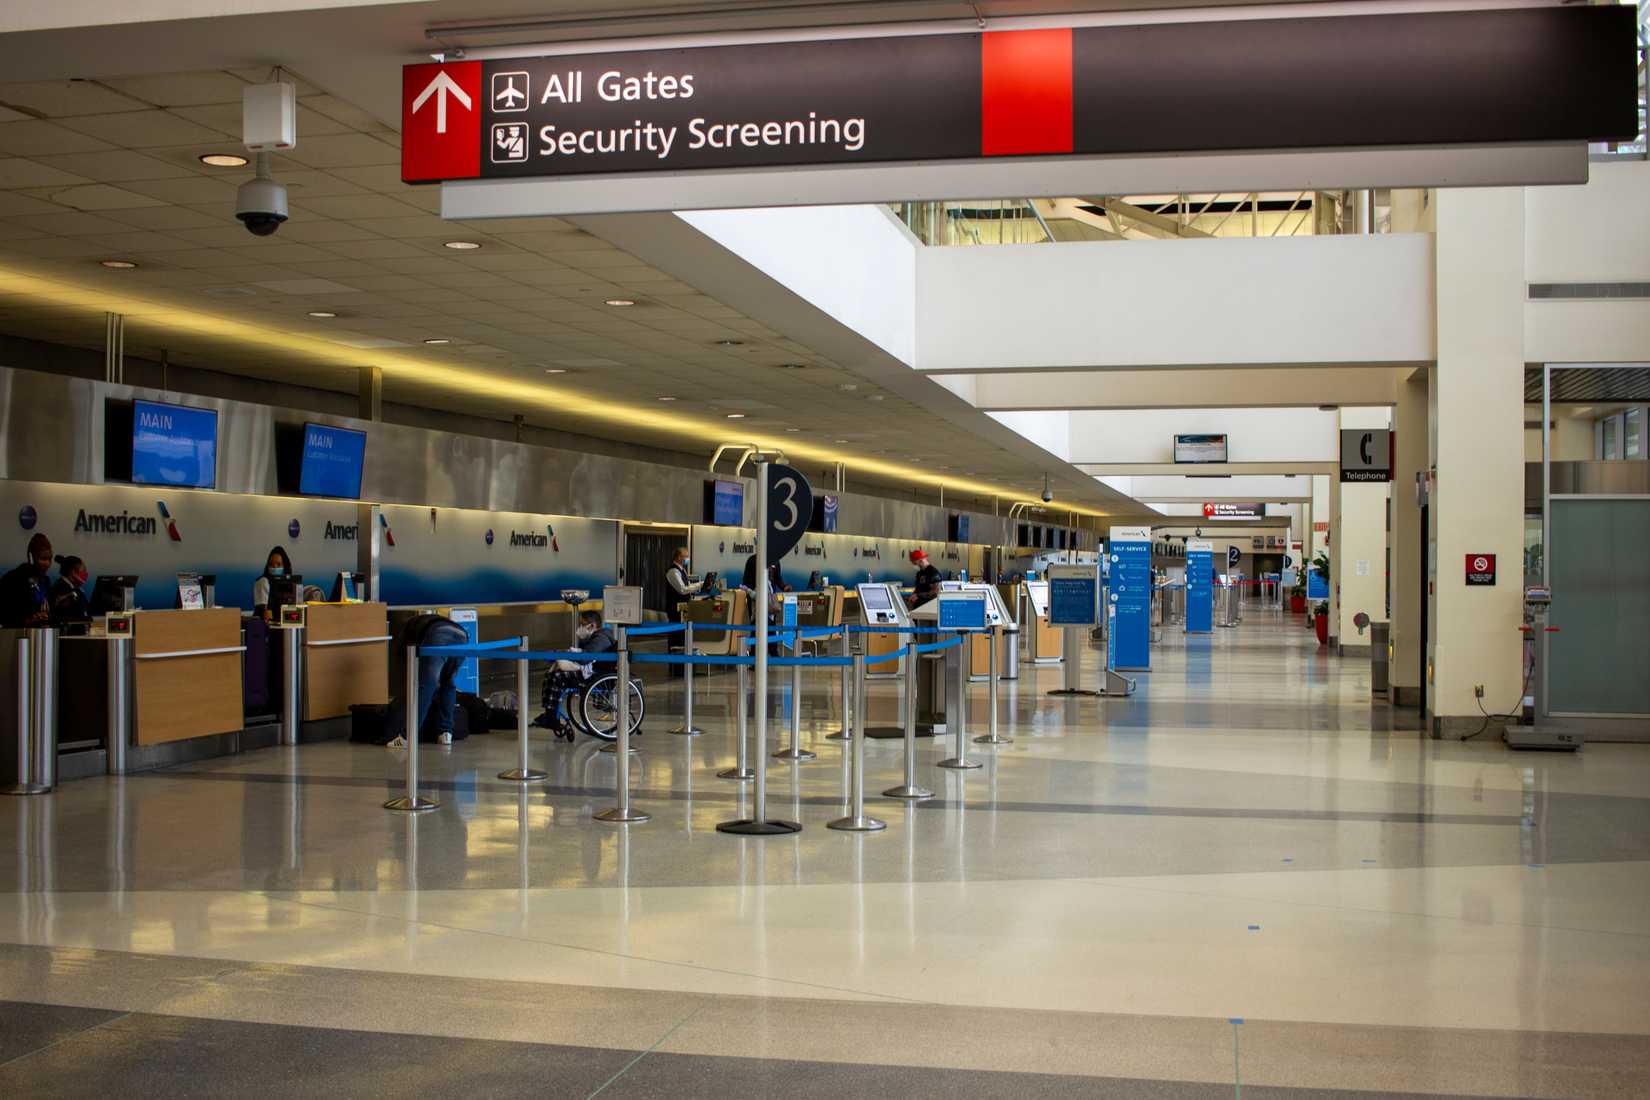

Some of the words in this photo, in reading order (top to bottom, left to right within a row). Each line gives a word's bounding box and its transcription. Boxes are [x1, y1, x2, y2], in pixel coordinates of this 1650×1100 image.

[541, 71, 582, 104] All
[597, 71, 694, 101] Gates
[539, 120, 677, 159] Security
[688, 112, 865, 151] Screening
[140, 411, 173, 431] MAIN
[307, 432, 333, 449] MAIN
[1345, 471, 1386, 481] Telephone
[773, 476, 799, 532] 3
[75, 508, 156, 534] American
[324, 520, 359, 540] Ameri
[510, 529, 548, 546] American
[733, 542, 754, 554] American
[1229, 548, 1238, 562] 2
